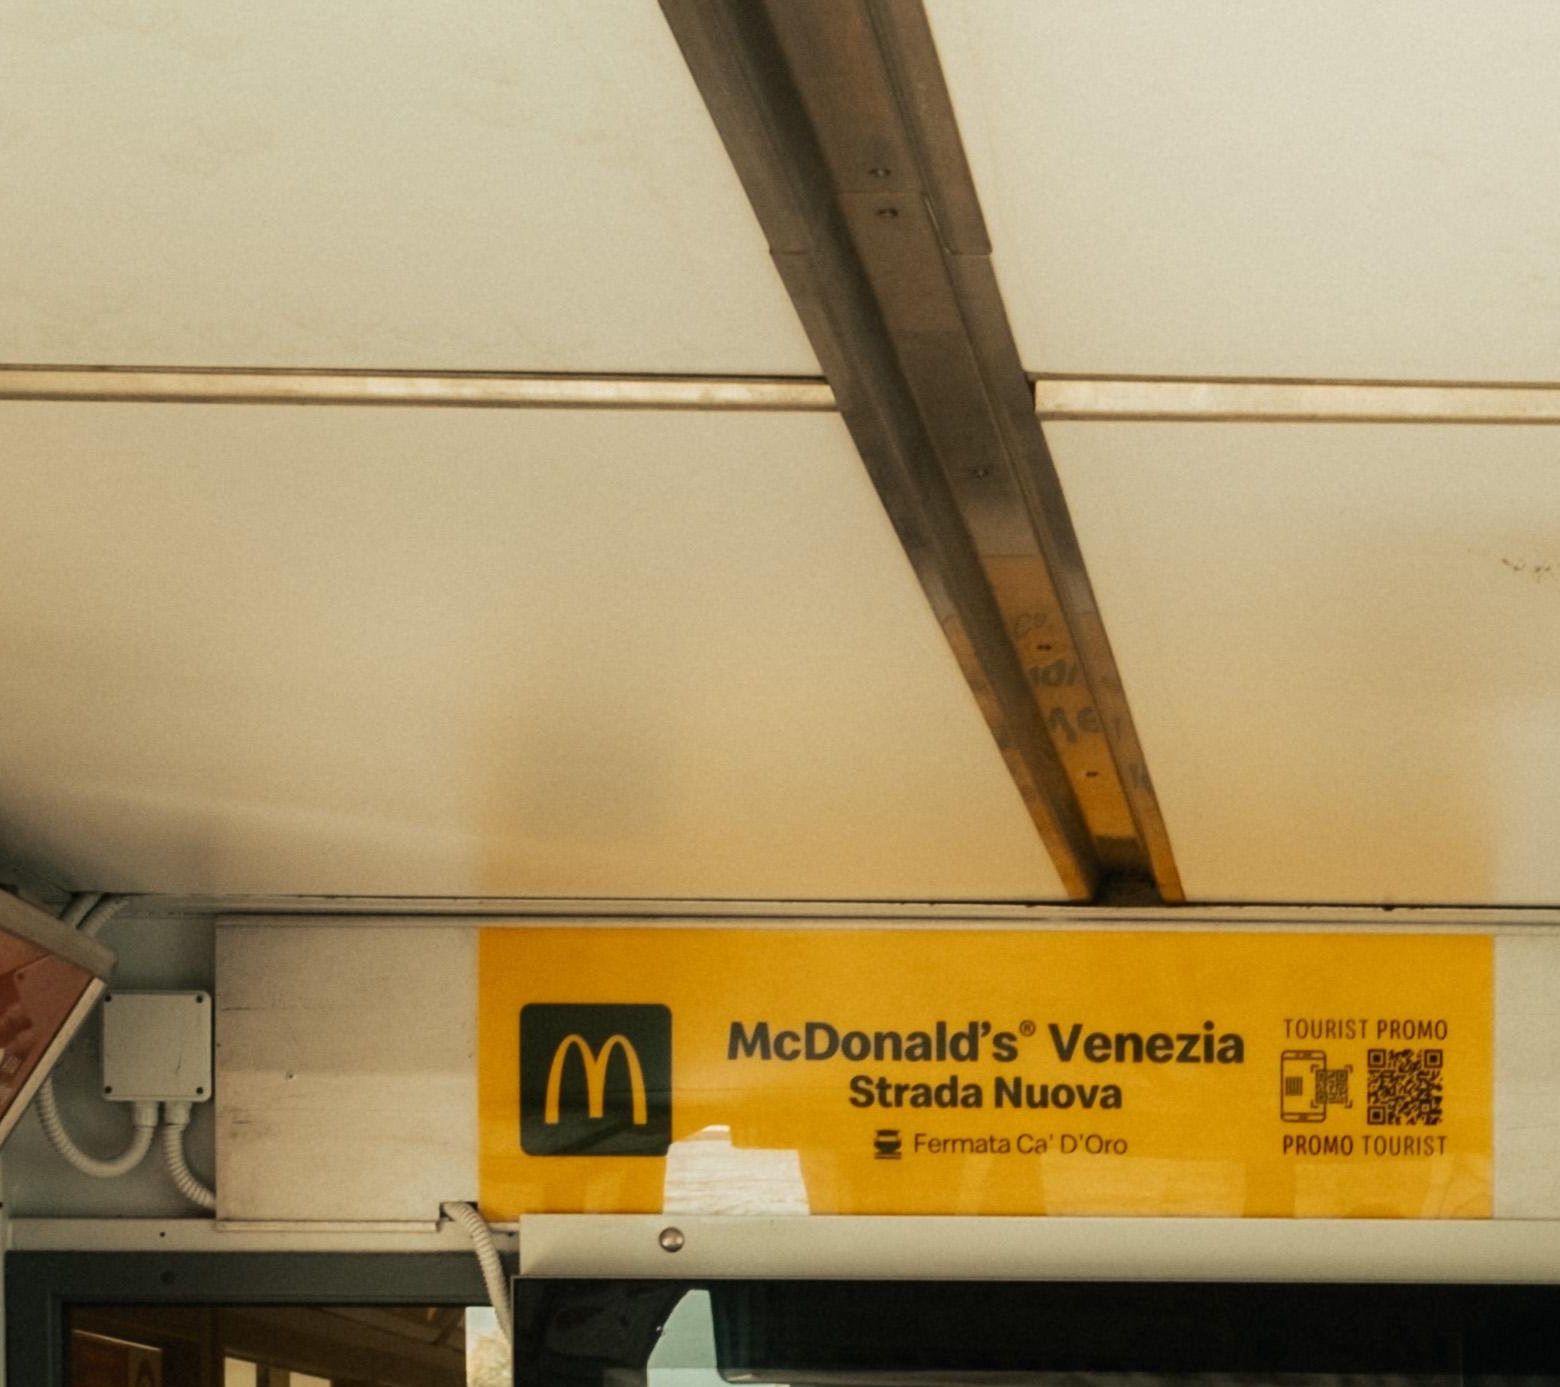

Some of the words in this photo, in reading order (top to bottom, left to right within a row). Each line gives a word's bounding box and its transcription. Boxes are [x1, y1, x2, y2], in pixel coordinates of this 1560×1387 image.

[1283, 1018, 1368, 1041] TOURIST
[1377, 1018, 1448, 1041] PROMO
[1048, 1020, 1245, 1064] Venezia
[849, 1075, 983, 1109] Strada
[994, 1076, 1123, 1110] Nuova
[914, 1132, 1011, 1154] Fermata
[1016, 1133, 1055, 1155] Ca'
[1060, 1133, 1128, 1155] D'Oro
[1283, 1134, 1354, 1156] PROMO
[1361, 1134, 1448, 1156] TOURIST
